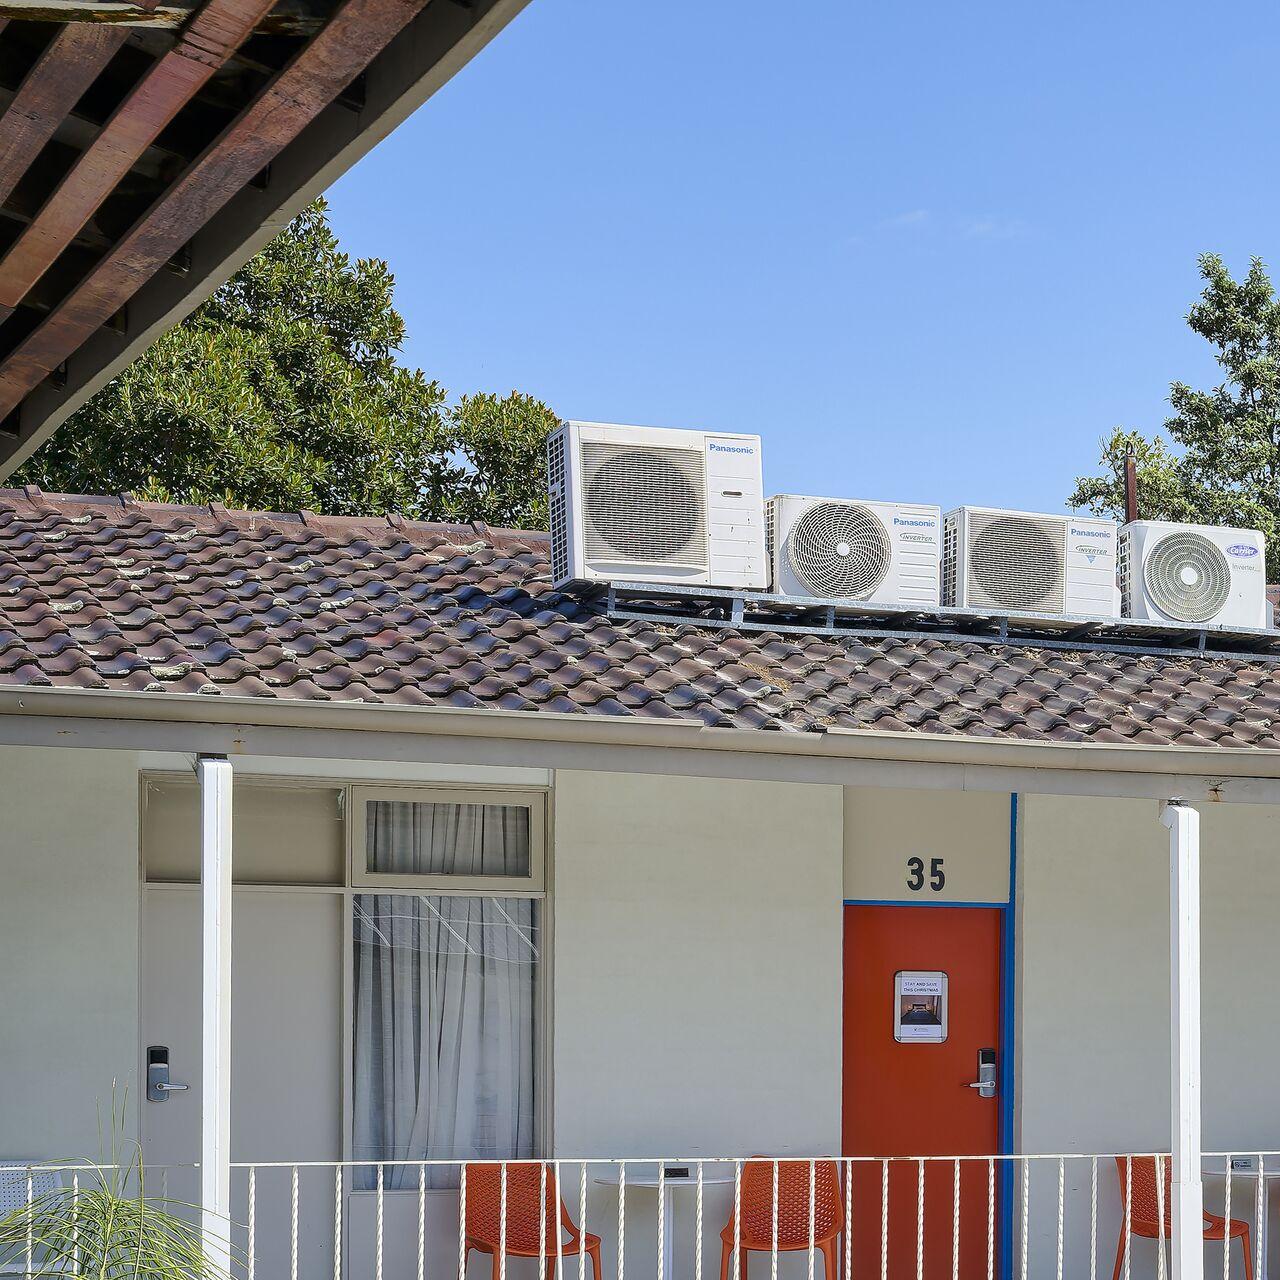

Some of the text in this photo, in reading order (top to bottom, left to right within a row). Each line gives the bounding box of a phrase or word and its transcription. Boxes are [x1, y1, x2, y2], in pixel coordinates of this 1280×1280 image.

[709, 443, 754, 454] Panasonic
[893, 517, 936, 527] Panasonic
[1071, 528, 1111, 538] Panasonic
[906, 856, 946, 892] 35
